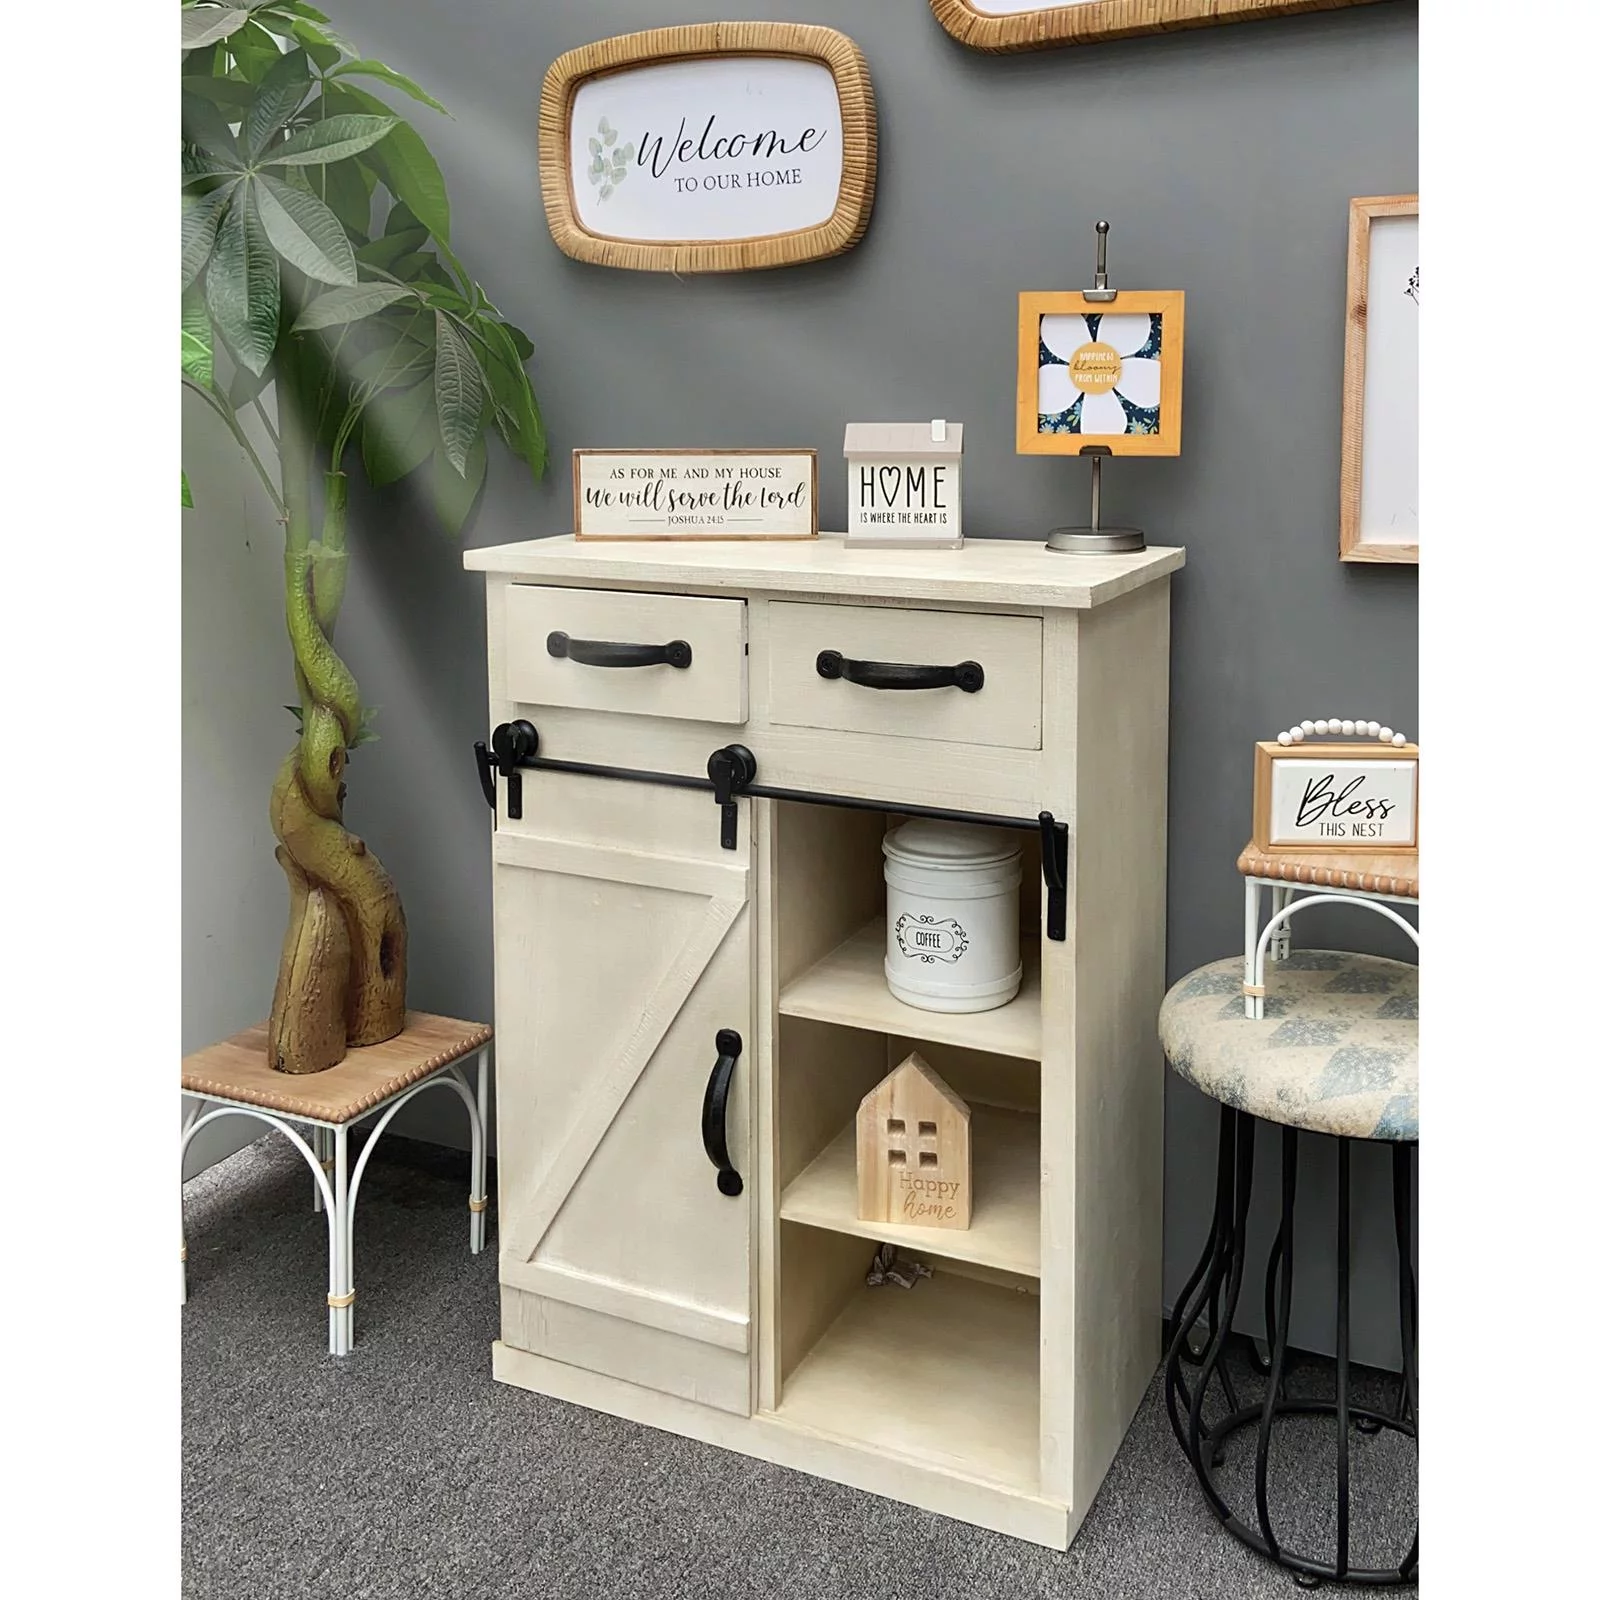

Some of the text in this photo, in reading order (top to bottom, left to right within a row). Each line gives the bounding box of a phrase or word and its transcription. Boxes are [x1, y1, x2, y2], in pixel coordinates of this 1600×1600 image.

[637, 114, 828, 179] Welcome
[674, 168, 803, 193] TO OUR HOME
[609, 468, 782, 479] AS FOR ME AND MY HOUSE
[619, 479, 666, 511] will
[668, 488, 720, 512] serve
[723, 480, 757, 510] the
[668, 515, 705, 526] JOSHUA
[860, 512, 947, 524] IS WHERE THE HEART IS
[1296, 774, 1396, 827] Bless
[1319, 822, 1384, 837] THIS NEST
[916, 931, 941, 948] COFFEE
[898, 1171, 961, 1200] Happy
[904, 1190, 957, 1220] home
